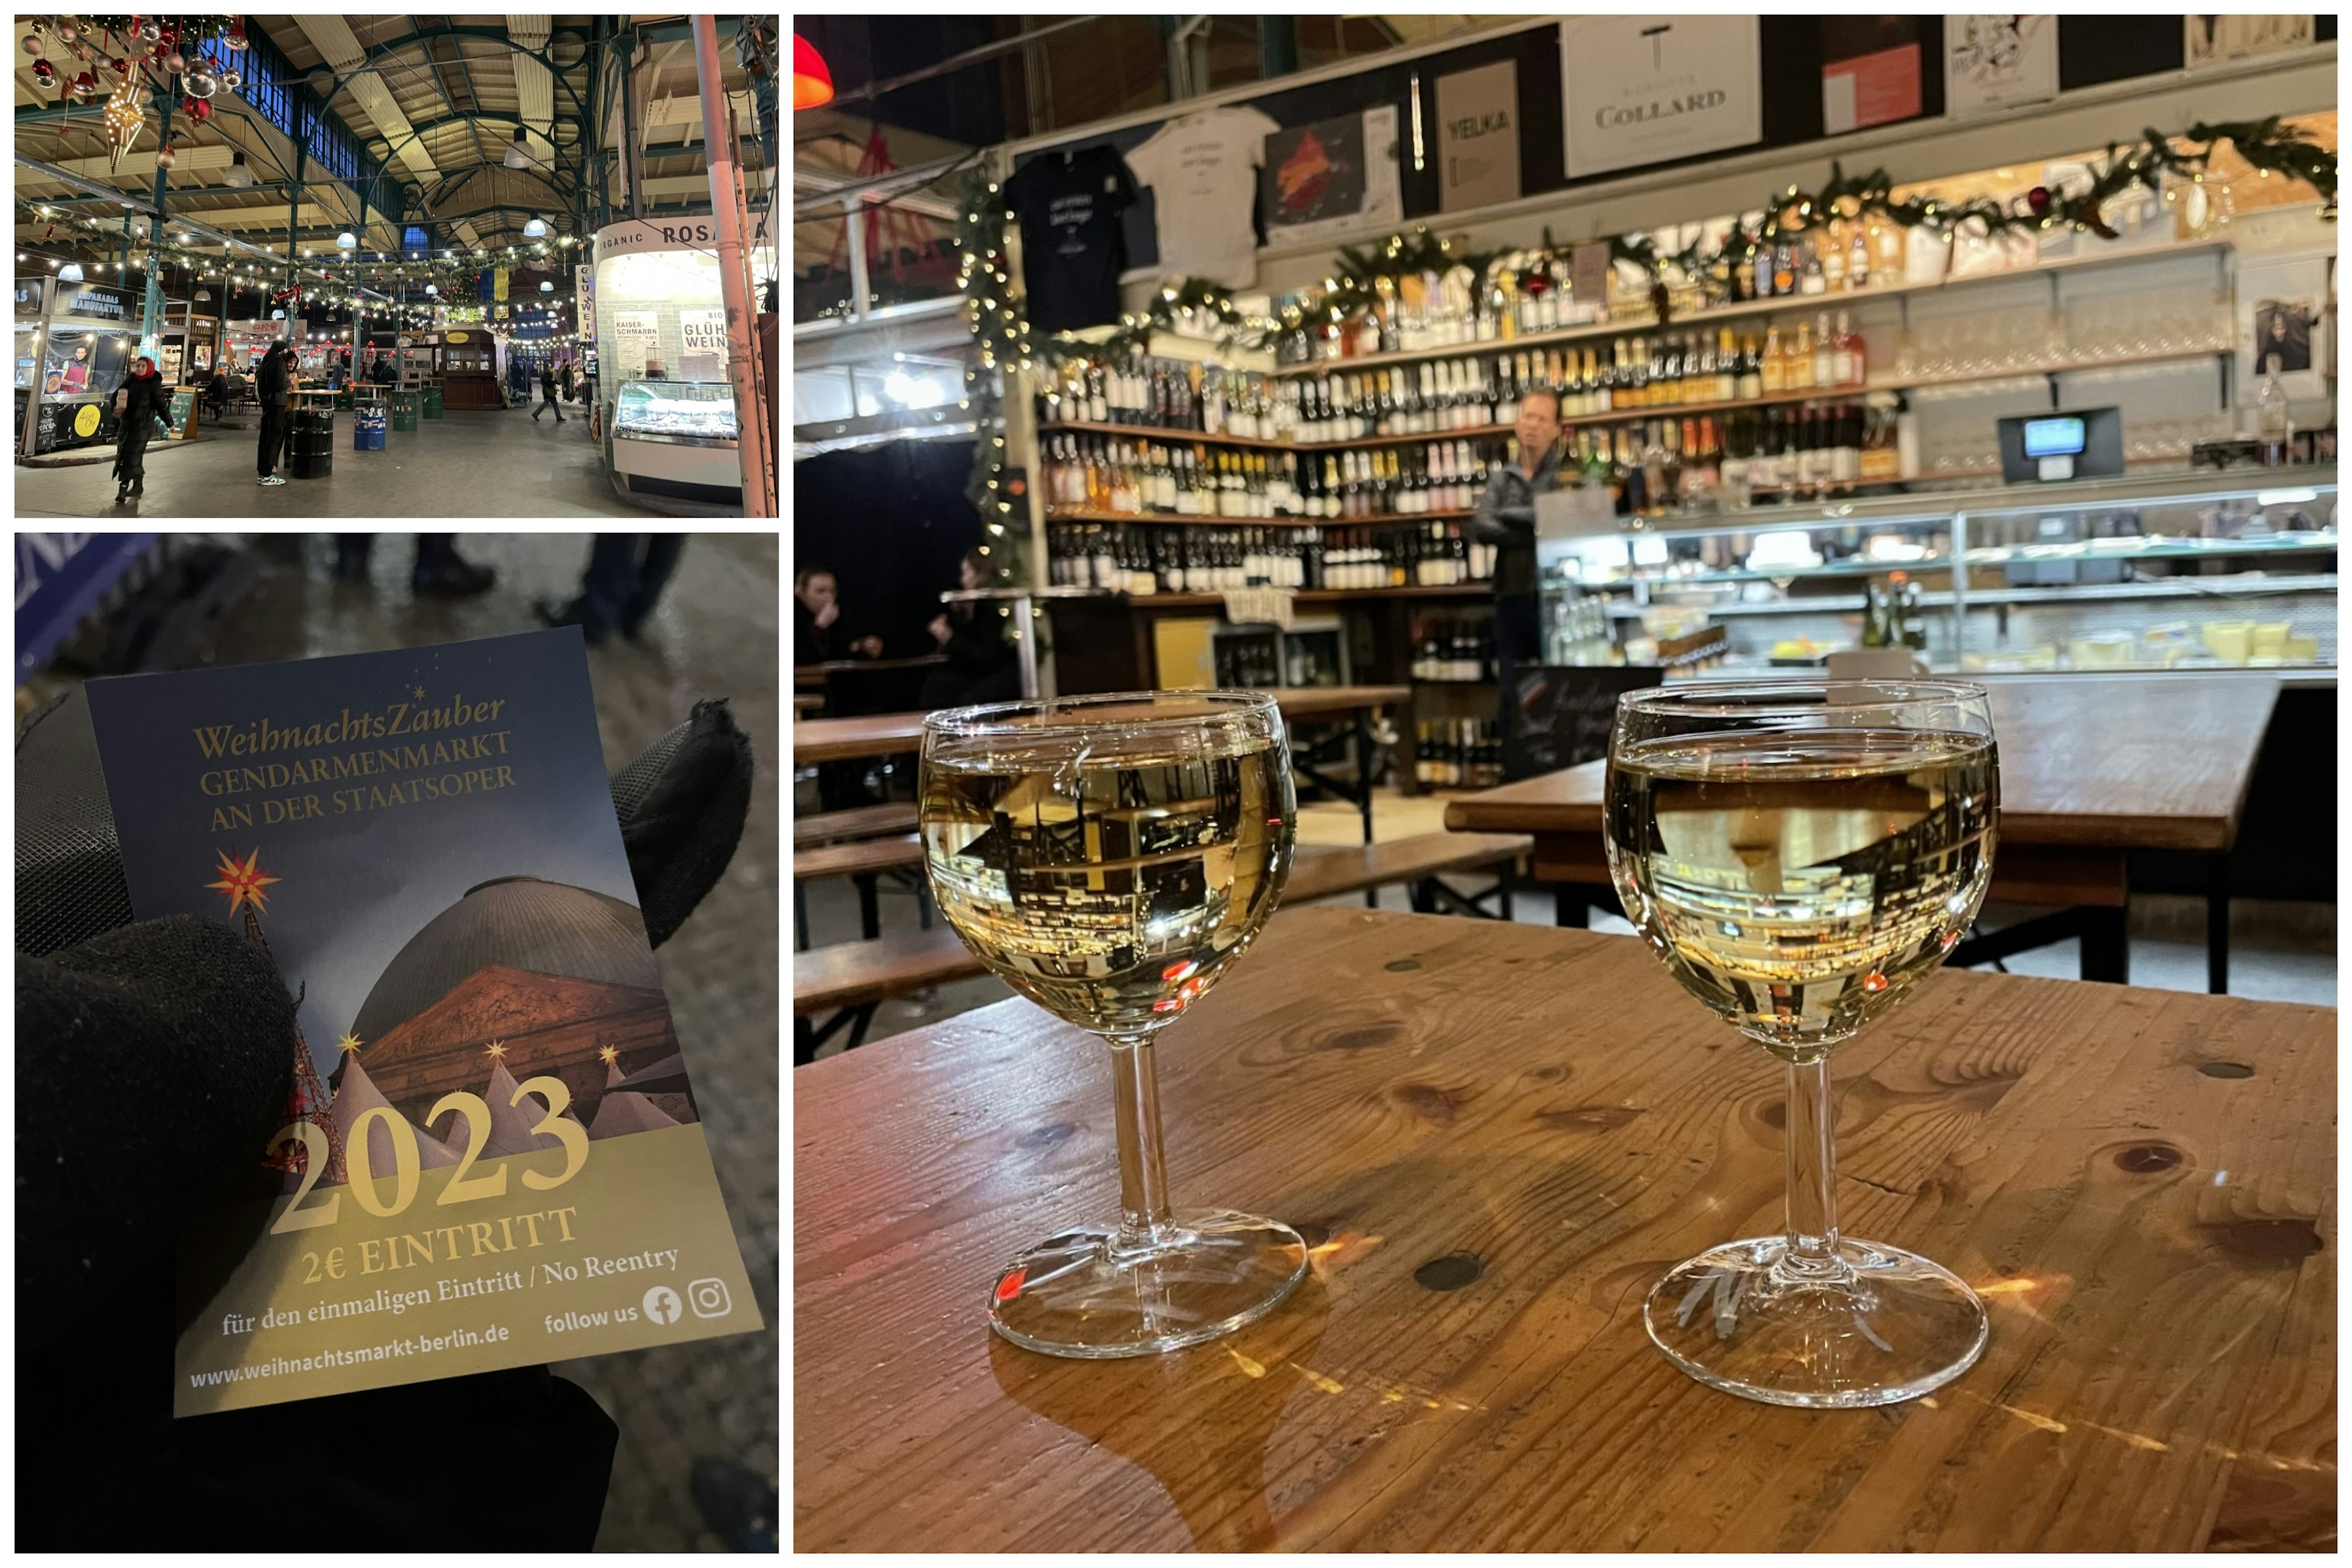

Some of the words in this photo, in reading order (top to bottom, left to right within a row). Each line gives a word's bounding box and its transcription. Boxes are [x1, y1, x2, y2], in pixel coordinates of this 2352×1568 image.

[600, 233, 643, 251] ORGANIC
[70, 298, 124, 314] MANUFAKTUR
[78, 290, 119, 304] EMPANADAS
[684, 322, 725, 335] GLÜH
[685, 336, 726, 347] WEIN
[192, 693, 505, 760] WeihnachtsZauber
[200, 731, 510, 796] GENDARMENMARKT
[211, 804, 252, 831] AN
[263, 794, 324, 824] DER
[333, 764, 517, 815] STAATSOPER
[265, 1076, 589, 1235] 2023
[301, 1246, 346, 1284] 2€
[358, 1206, 577, 1275] EINTRITT
[222, 1314, 256, 1336] für
[262, 1308, 301, 1330] den
[307, 1289, 431, 1322] einmaligen
[436, 1269, 523, 1302] Eintritt
[529, 1265, 535, 1288] /
[541, 1261, 578, 1284] No
[582, 1249, 679, 1278] Reentry
[545, 1311, 608, 1334] follow
[614, 1306, 639, 1323] us
[191, 1324, 510, 1388] www.weihnachtsmarkt-berlin.de
